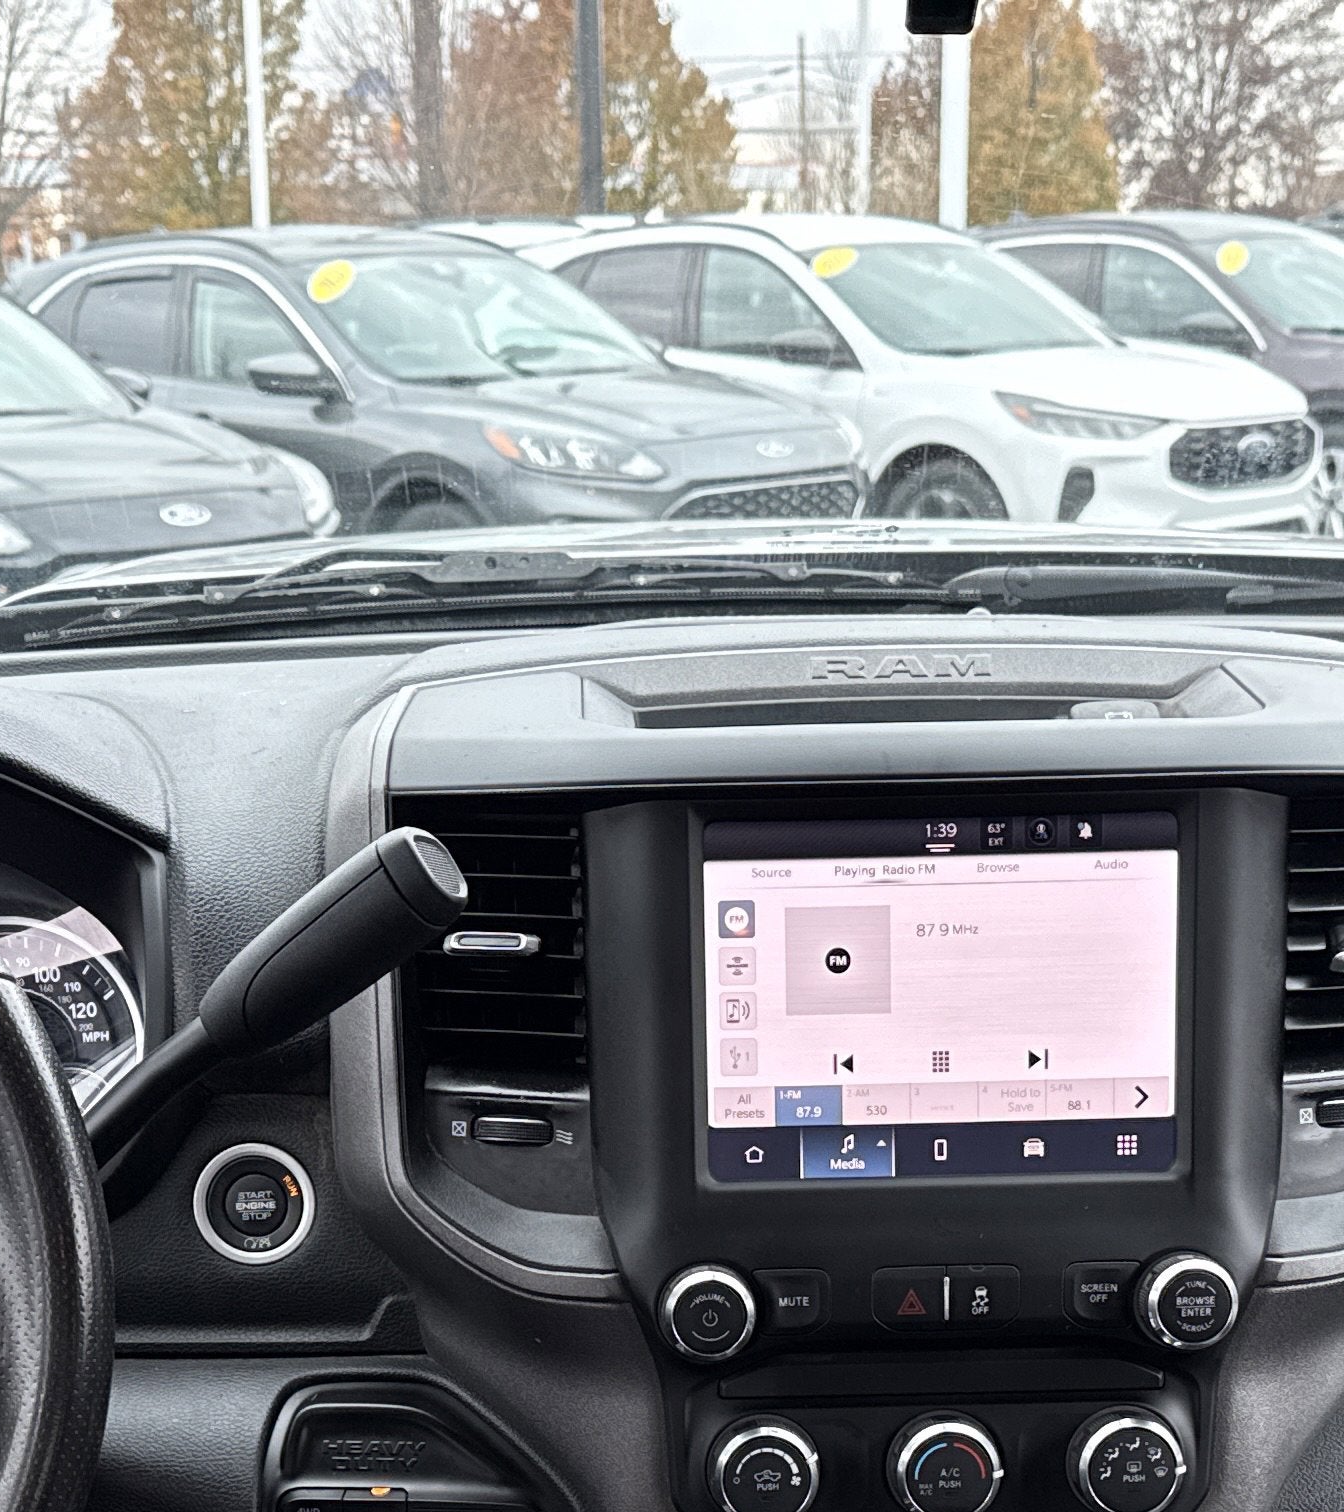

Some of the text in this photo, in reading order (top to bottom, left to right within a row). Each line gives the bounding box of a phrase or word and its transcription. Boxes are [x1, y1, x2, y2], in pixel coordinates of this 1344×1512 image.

[810, 653, 993, 680] RAM
[925, 822, 958, 839] 1:39
[751, 858, 1129, 880] Source Playing Radio FM Browse Audio
[952, 924, 979, 935] MHz
[829, 955, 847, 967] FM
[32, 967, 61, 983] 100
[64, 981, 81, 993] 110
[68, 1002, 98, 1019] 120
[82, 1031, 110, 1043] MPH
[1001, 1087, 1041, 1098] Hold to
[737, 1094, 752, 1105] All
[866, 1105, 888, 1116] 530
[1008, 1102, 1034, 1113] Save
[1067, 1100, 1091, 1111] 88.1
[724, 1108, 765, 1120] Presets
[796, 1106, 822, 1118] 87.9
[830, 1158, 866, 1170] Media
[282, 1175, 300, 1198] RUN
[237, 1190, 273, 1200] START
[235, 1201, 277, 1211] ENGINE
[241, 1212, 272, 1221] STOP
[1080, 1283, 1119, 1294] SCREEN
[1185, 1280, 1208, 1290] TUNE
[692, 1293, 726, 1305] VOLUME
[778, 1296, 810, 1308] MUTE
[1089, 1294, 1109, 1304] OFF
[1175, 1296, 1216, 1306] BROWSE
[971, 1306, 990, 1316] OFF
[1181, 1307, 1212, 1318] ENTER
[1181, 1320, 1212, 1333] SCROLL
[322, 1439, 426, 1457] HEAVY
[331, 1456, 419, 1473] DUTY
[939, 1467, 961, 1478] A/C
[1122, 1473, 1146, 1483] PUSH
[756, 1482, 780, 1492] PUSH
[938, 1480, 962, 1489] PUSH
